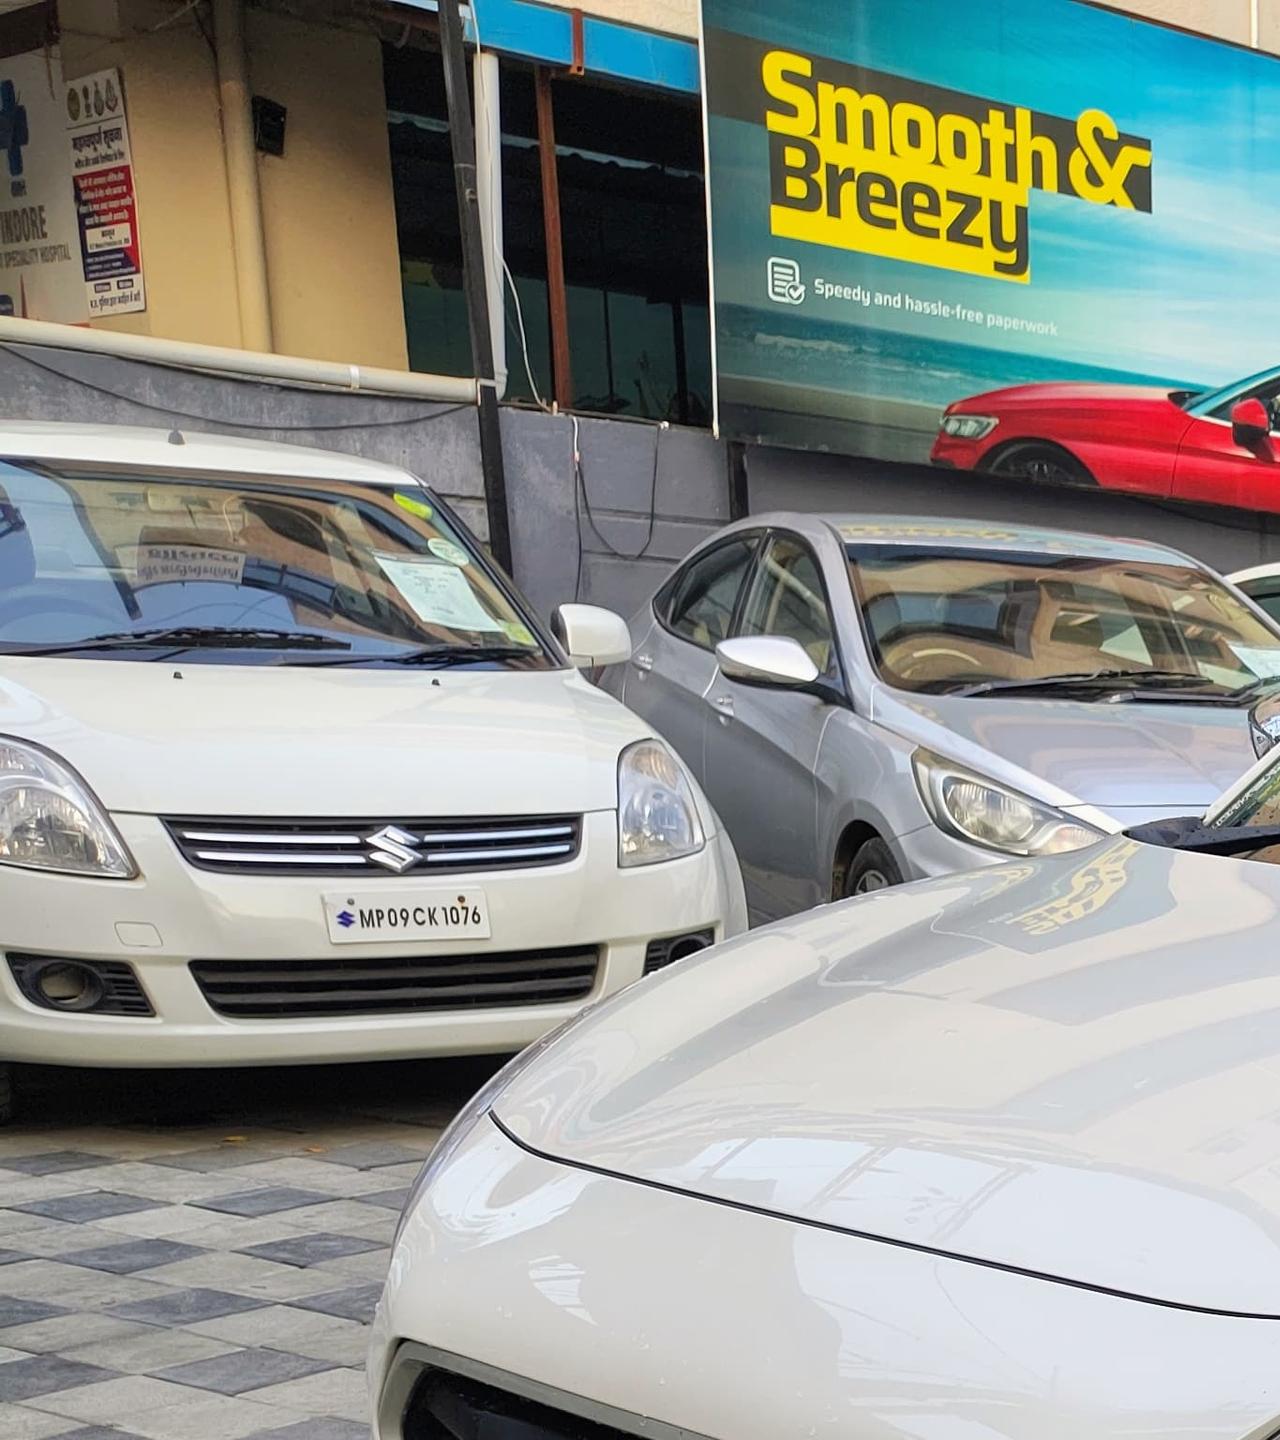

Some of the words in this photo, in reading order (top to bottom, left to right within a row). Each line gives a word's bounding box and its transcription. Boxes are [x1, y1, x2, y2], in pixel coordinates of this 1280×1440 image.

[762, 50, 1057, 191] Smooth
[1068, 109, 1152, 210] &
[769, 131, 1029, 275] Breezy
[814, 278, 871, 306] Speedy
[874, 292, 901, 309] and
[905, 295, 983, 324] hassle-free
[987, 312, 1059, 337] paperwork
[359, 905, 481, 929] MP09CK1076
